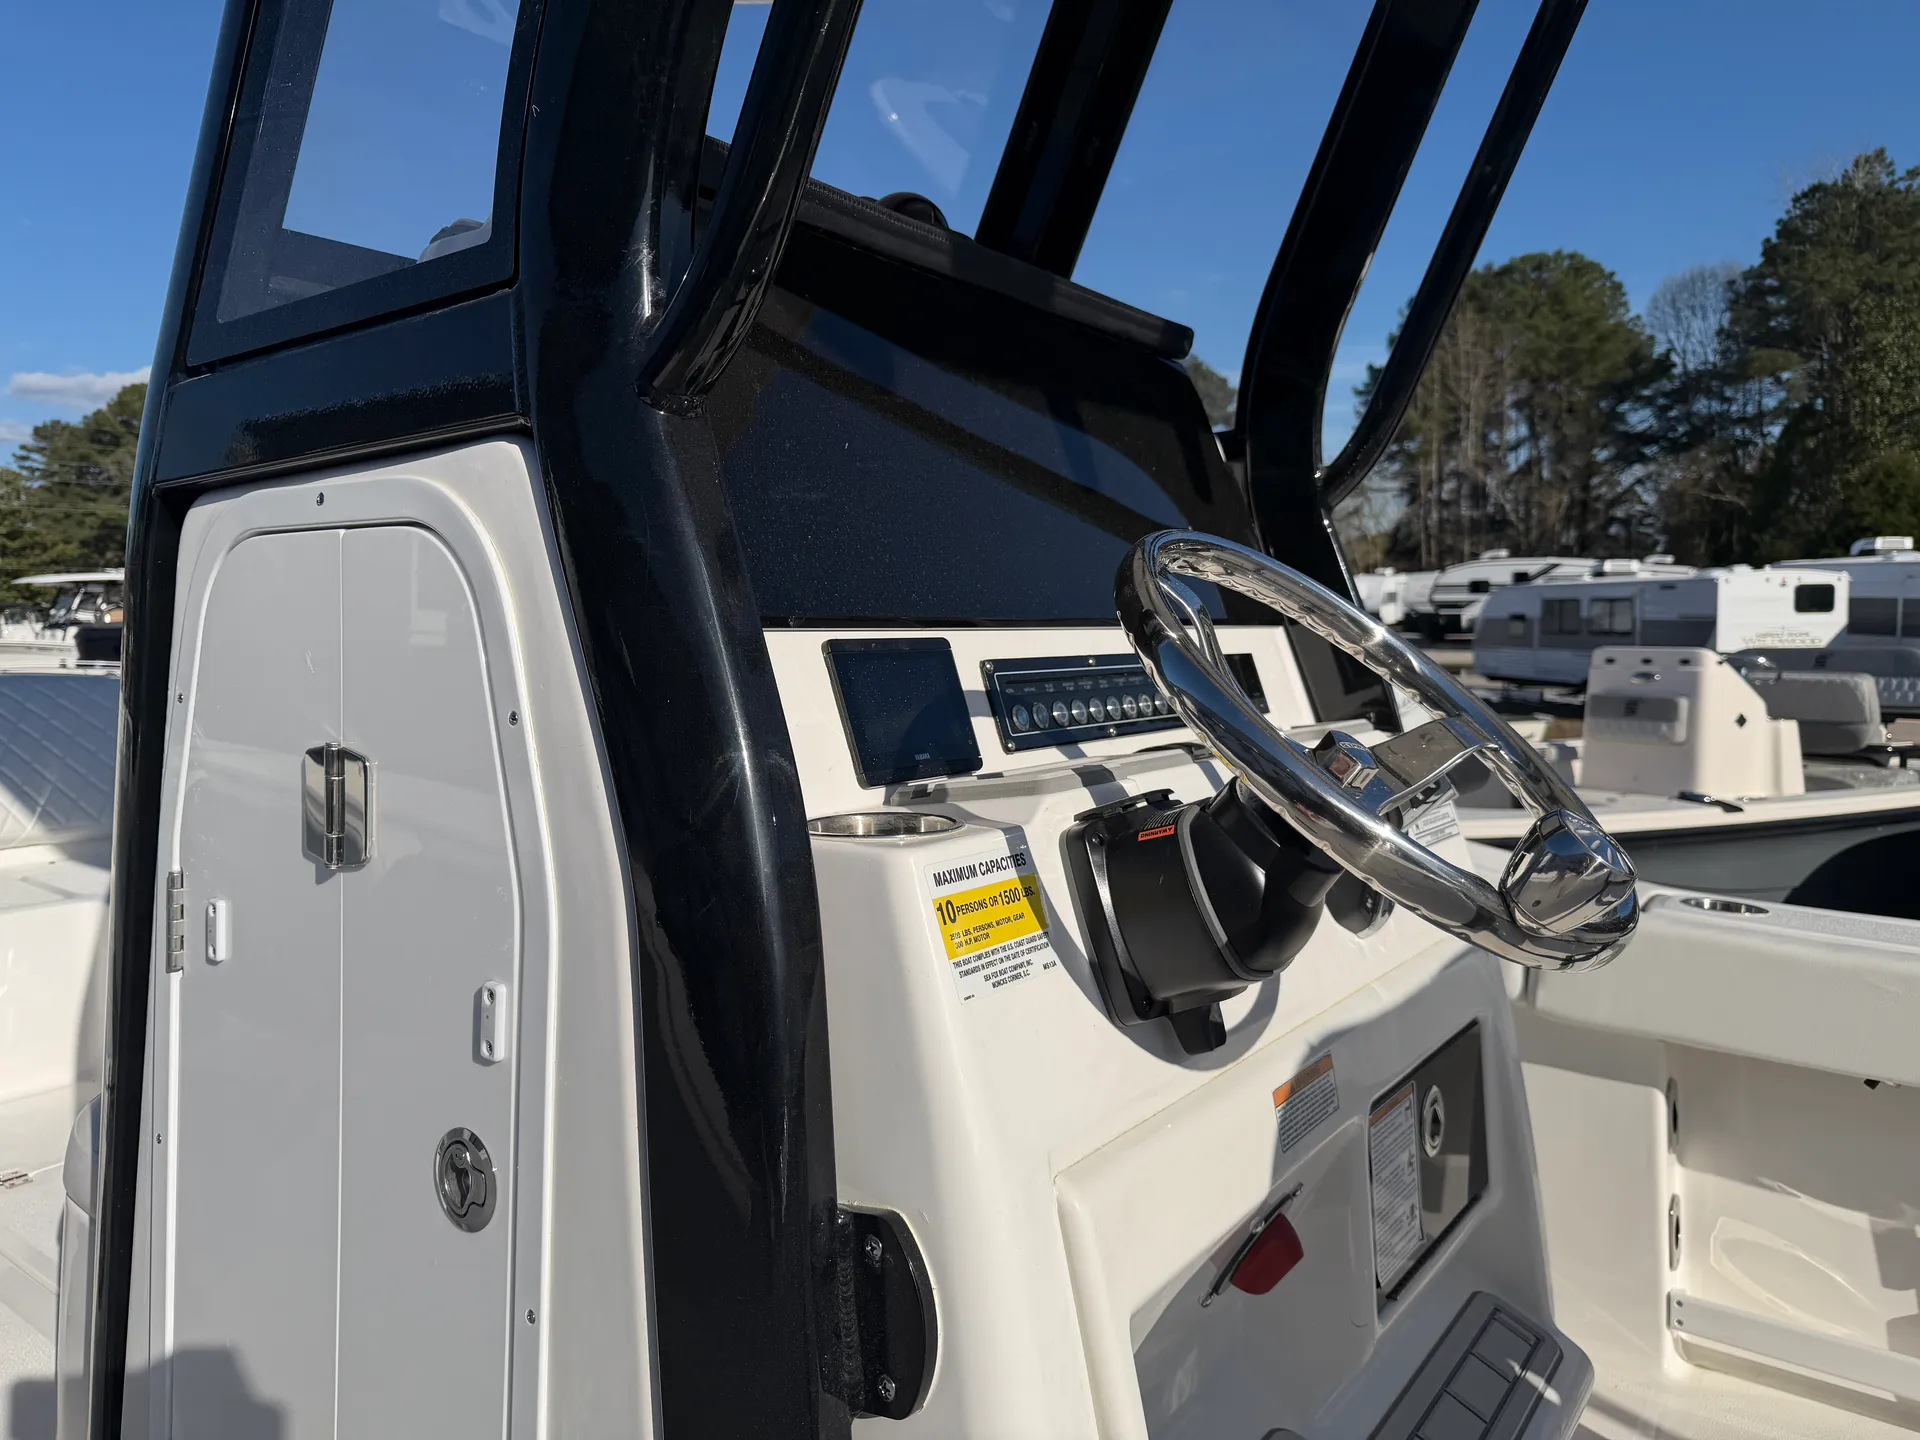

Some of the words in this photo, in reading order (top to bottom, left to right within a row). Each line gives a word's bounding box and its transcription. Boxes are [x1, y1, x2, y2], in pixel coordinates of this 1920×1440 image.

[1141, 828, 1167, 839] WARNING
[933, 864, 978, 887] MAXIMUM
[979, 852, 1027, 876] CAPACITIES
[936, 899, 957, 926] 10
[956, 898, 988, 917] PERSONS
[988, 895, 999, 907] OR
[999, 887, 1021, 906] 1500
[1021, 886, 1035, 898] LBS.
[973, 921, 996, 933] PERSONS,
[996, 915, 1013, 927] MOTOR,
[1013, 912, 1025, 922] GEAR
[974, 932, 991, 943] MOTOR
[953, 960, 962, 970] THIS
[962, 957, 973, 967] BOAT
[973, 951, 991, 963] COMPLIES
[991, 948, 1000, 957] WITH
[999, 946, 1007, 954] THE
[1014, 938, 1026, 949] COAST
[1026, 935, 1037, 944] GUARD
[959, 965, 981, 979] STANDARDS
[981, 963, 986, 971] IN
[985, 958, 998, 969] EFFECT
[998, 956, 1005, 965] ON
[1004, 954, 1012, 963] THE
[1011, 950, 1021, 960] DATE
[1020, 948, 1026, 957] OF
[1025, 941, 1050, 955] CERTIFICATION
[983, 973, 991, 982] SEA
[991, 969, 999, 979] FOX
[999, 966, 1009, 976] BOAT
[1026, 958, 1034, 967] INC.
[991, 977, 1008, 989] MONCKS
